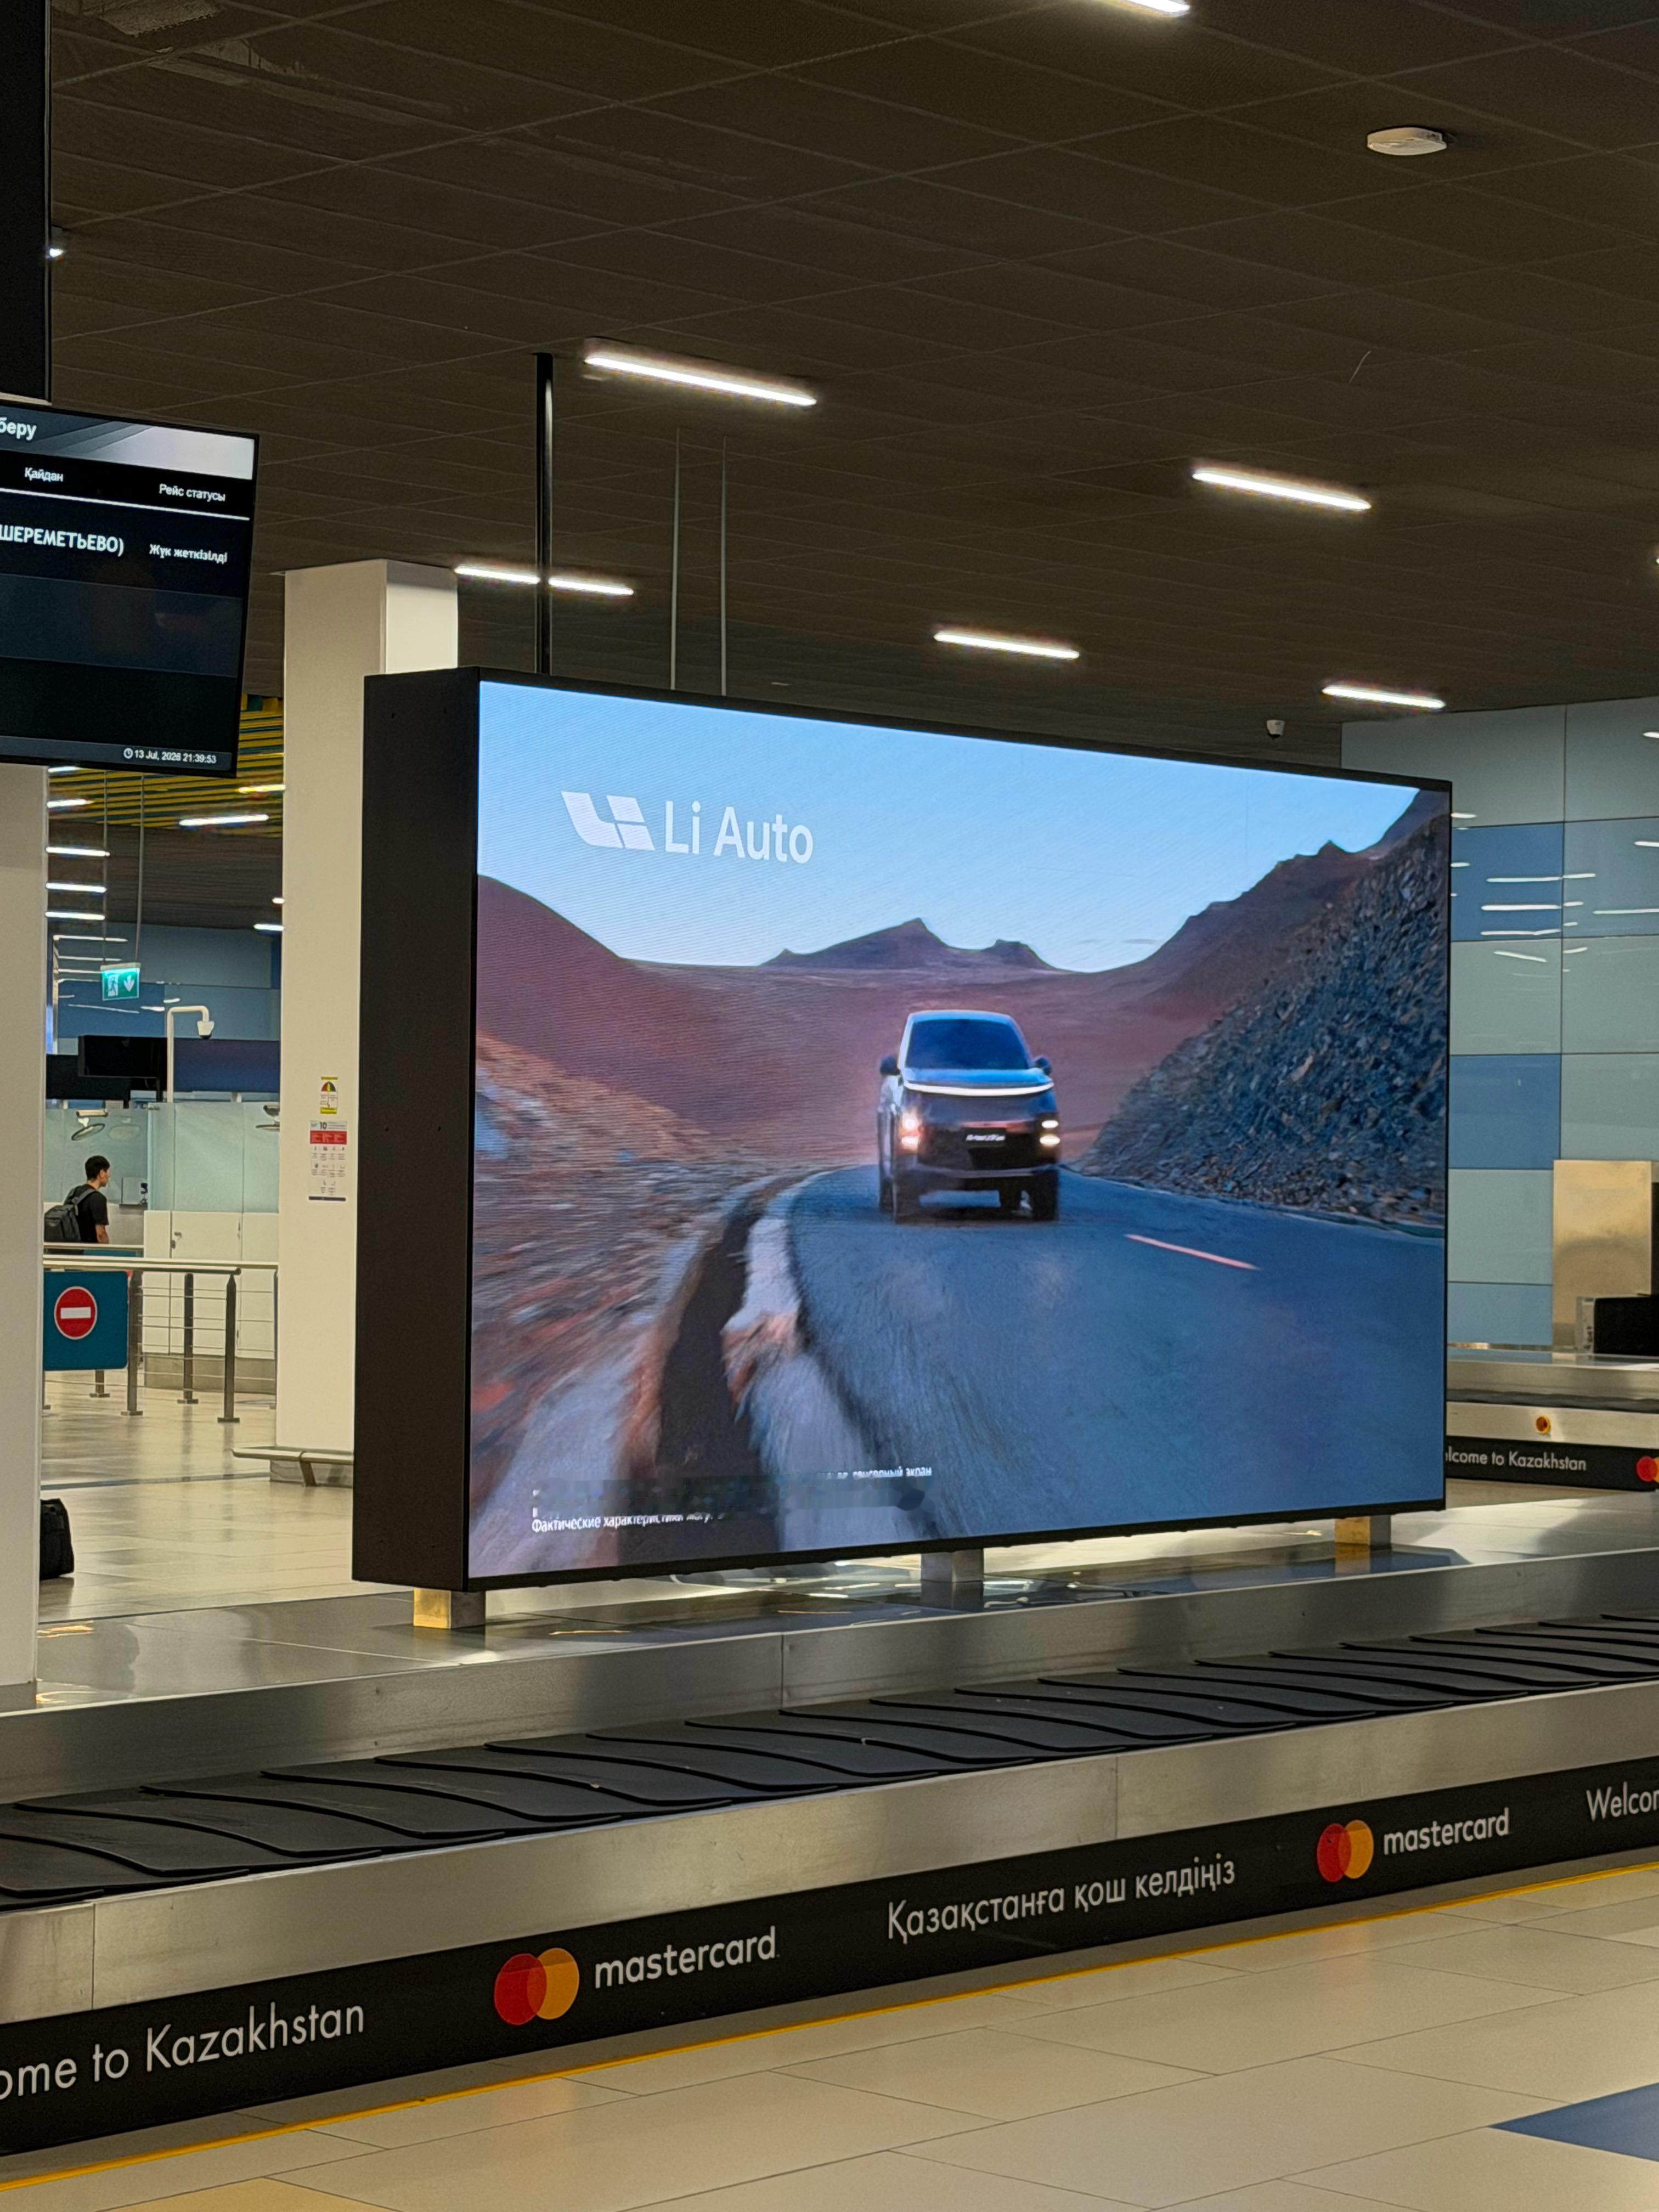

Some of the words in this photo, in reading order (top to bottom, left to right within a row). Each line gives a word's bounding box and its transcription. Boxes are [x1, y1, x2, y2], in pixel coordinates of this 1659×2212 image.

[25, 467, 63, 482] Қайдан
[159, 481, 184, 496] Рейс
[186, 489, 225, 502] статусы
[0, 524, 124, 557] ШЕРЕМЕТЬЕВО)
[149, 544, 172, 558] Жүк
[173, 549, 228, 565] жеткізілді
[134, 749, 144, 759] 13
[183, 753, 216, 764] 21:39:53
[665, 800, 701, 854] Li
[713, 806, 814, 864] Auto
[1492, 1452, 1504, 1466] to
[1509, 1451, 1587, 1471] Kazakhstan
[532, 1516, 601, 1533] Фактические
[1384, 1807, 1510, 1855] mastercard
[888, 1887, 1064, 1944] Қазақстанға
[1074, 1878, 1126, 1912] қош
[1135, 1853, 1235, 1898] келдіңіз
[595, 1925, 776, 1988] mastercard
[92, 2044, 129, 2082] to
[146, 2002, 364, 2072] Kazakhstan
